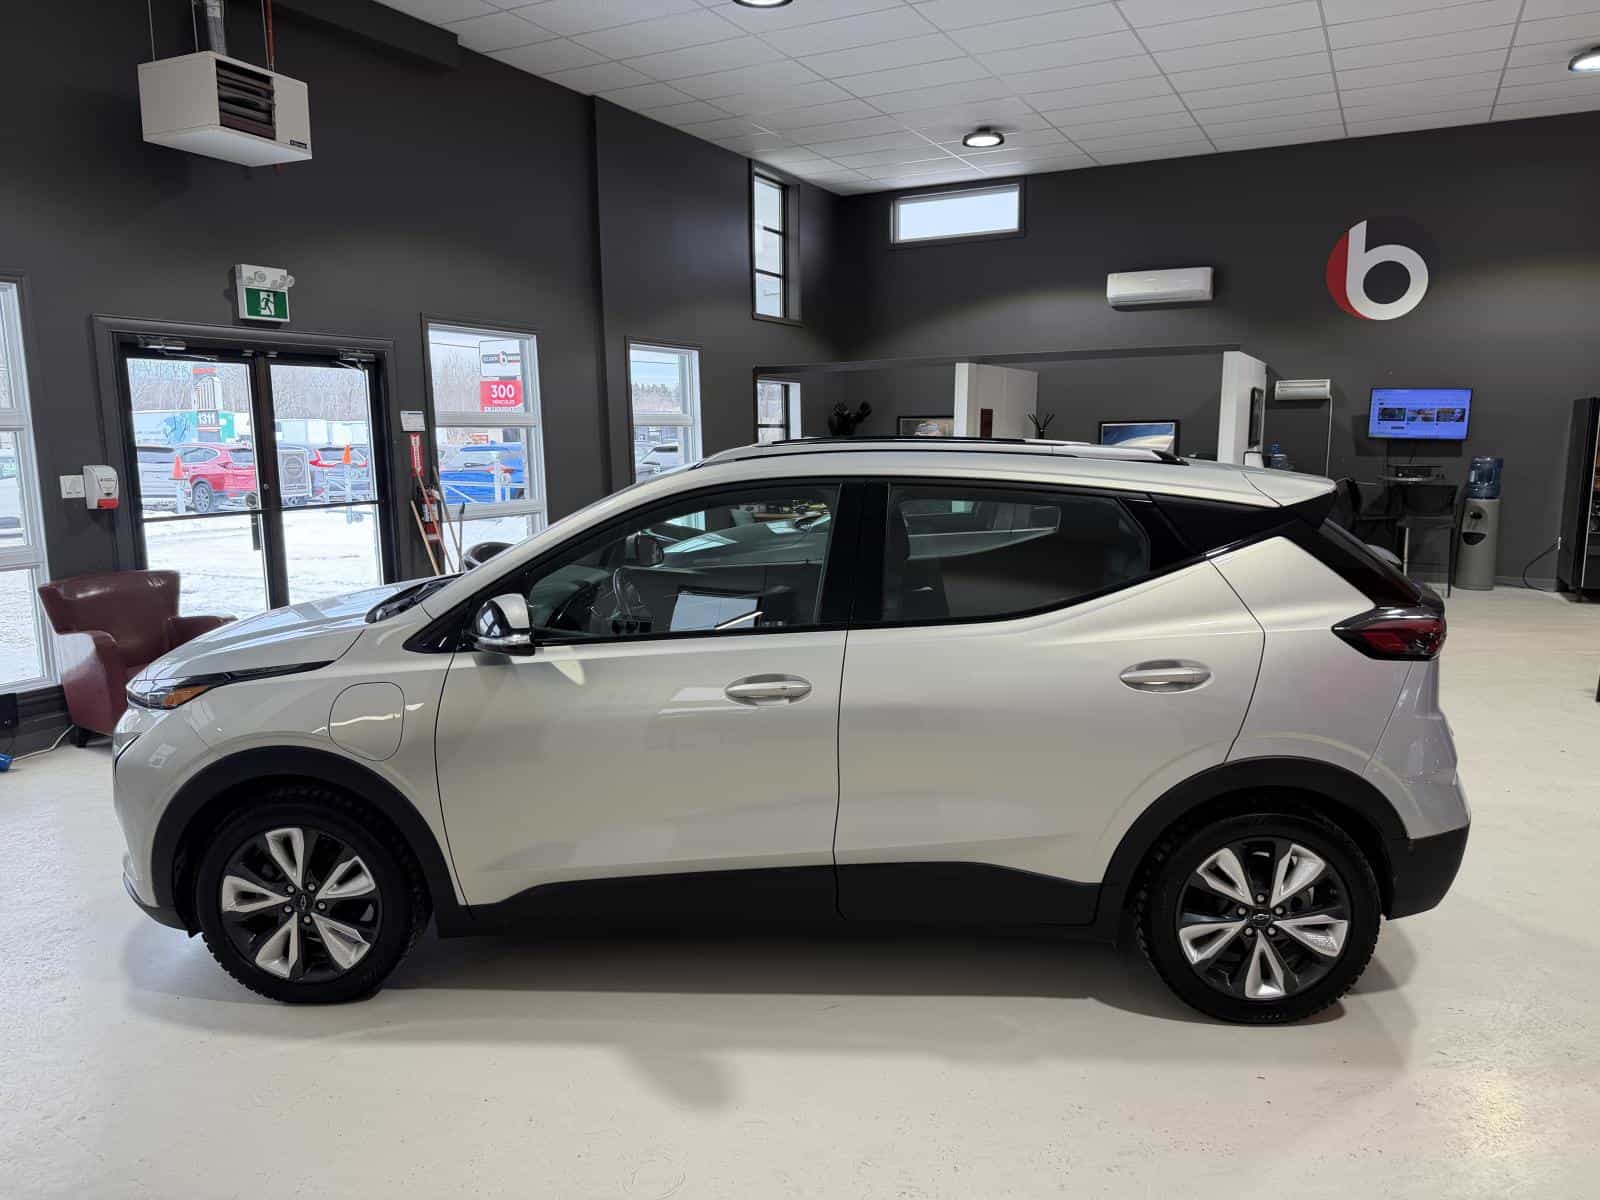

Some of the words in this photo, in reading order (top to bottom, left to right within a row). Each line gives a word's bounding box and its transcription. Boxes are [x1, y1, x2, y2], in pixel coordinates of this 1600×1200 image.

[1346, 219, 1429, 320] b
[490, 384, 515, 398] 300
[199, 413, 216, 425] 1311
